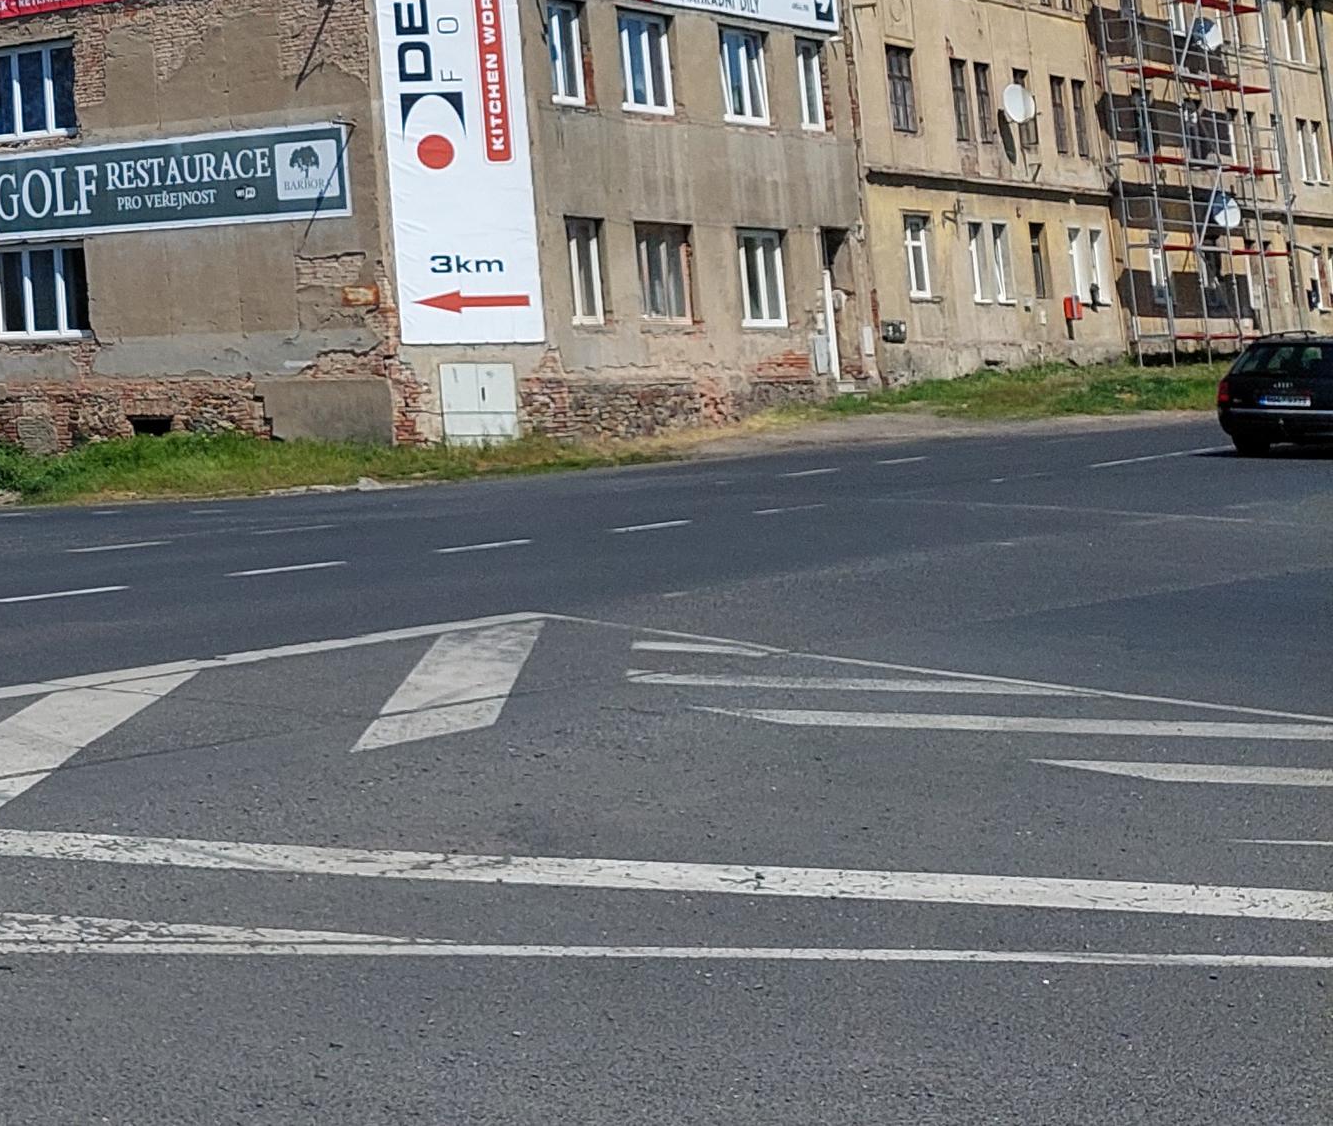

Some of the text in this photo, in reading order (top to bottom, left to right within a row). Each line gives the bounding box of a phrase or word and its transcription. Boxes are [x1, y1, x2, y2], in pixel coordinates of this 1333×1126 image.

[485, 53, 505, 152] KITCHEN
[105, 148, 271, 190] RESTAURACE
[117, 189, 217, 211] PRO VEŘEJNOST
[430, 255, 504, 273] 3km
